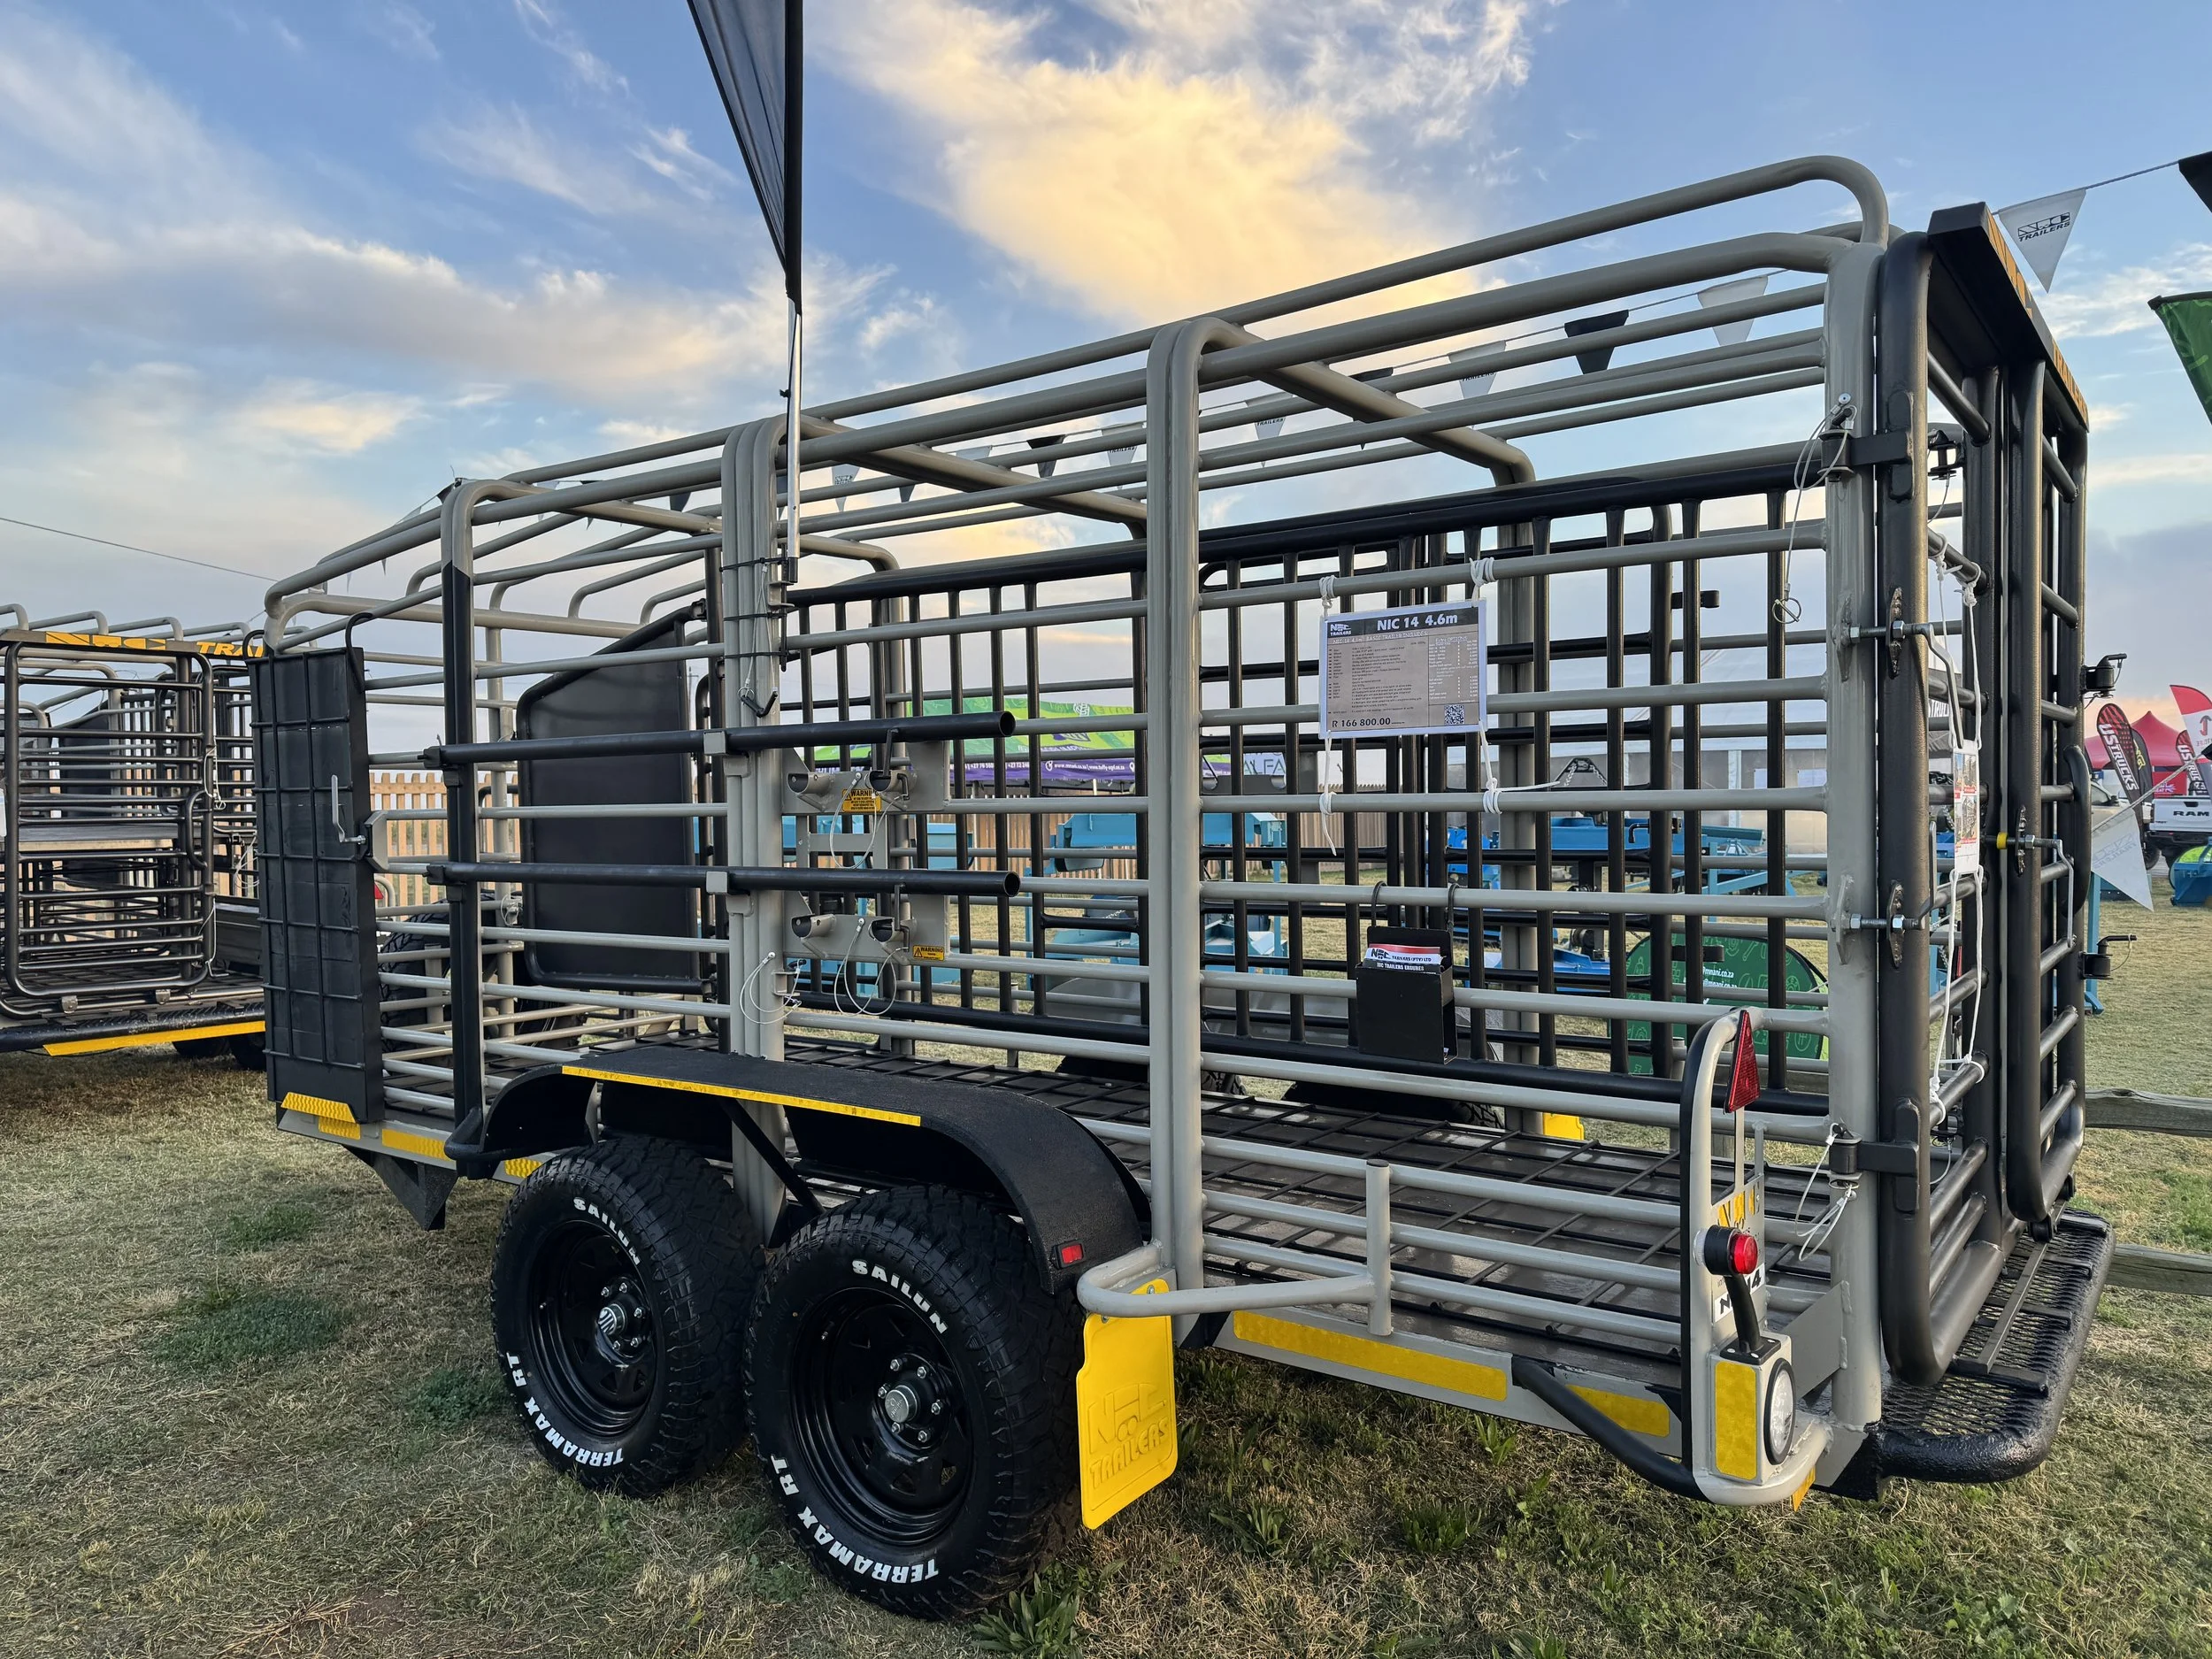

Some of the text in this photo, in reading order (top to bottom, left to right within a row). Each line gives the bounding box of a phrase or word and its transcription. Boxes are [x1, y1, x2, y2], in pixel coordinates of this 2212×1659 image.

[2018, 221, 2070, 242] TRAILERS
[2052, 340, 2089, 426] TRAILERS
[1377, 613, 1458, 631] NIC 14 4.6m
[1359, 717, 1391, 726] 800.00
[572, 1197, 641, 1266] SAILUN
[851, 1259, 949, 1335] SAILUN
[506, 1351, 624, 1468] TERRAMAX RT
[1089, 1417, 1170, 1491] TRAILERS
[770, 1454, 940, 1585] TERRAMAX RT
